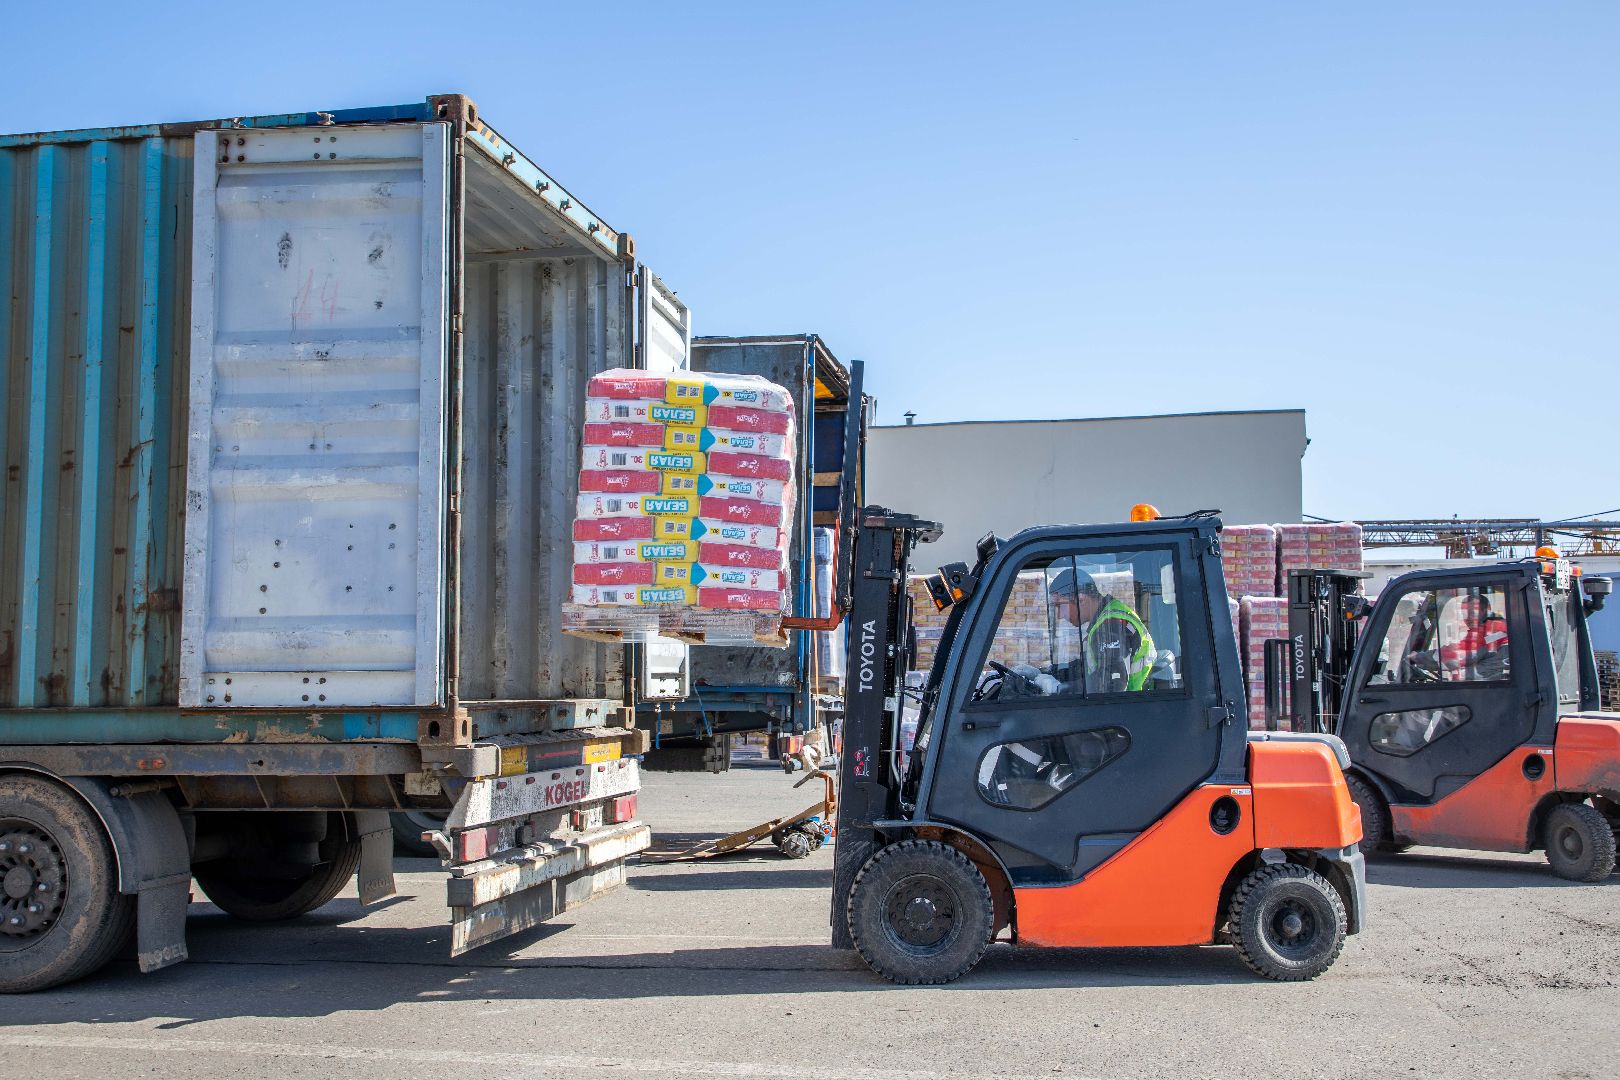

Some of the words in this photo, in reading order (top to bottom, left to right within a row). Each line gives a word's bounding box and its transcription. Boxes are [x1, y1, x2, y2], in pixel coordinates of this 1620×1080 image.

[653, 407, 695, 420] БЕЛАЯ
[650, 454, 692, 467] БЕЛАЯ
[729, 484, 751, 492] БЕЛАЯ
[645, 499, 688, 512] БЕЛАЯ
[642, 545, 685, 557] БЕЛАЯ
[641, 590, 684, 602] БЕЛАЯ
[859, 620, 876, 692] TOYOTA
[1295, 634, 1304, 680] TOYOTA
